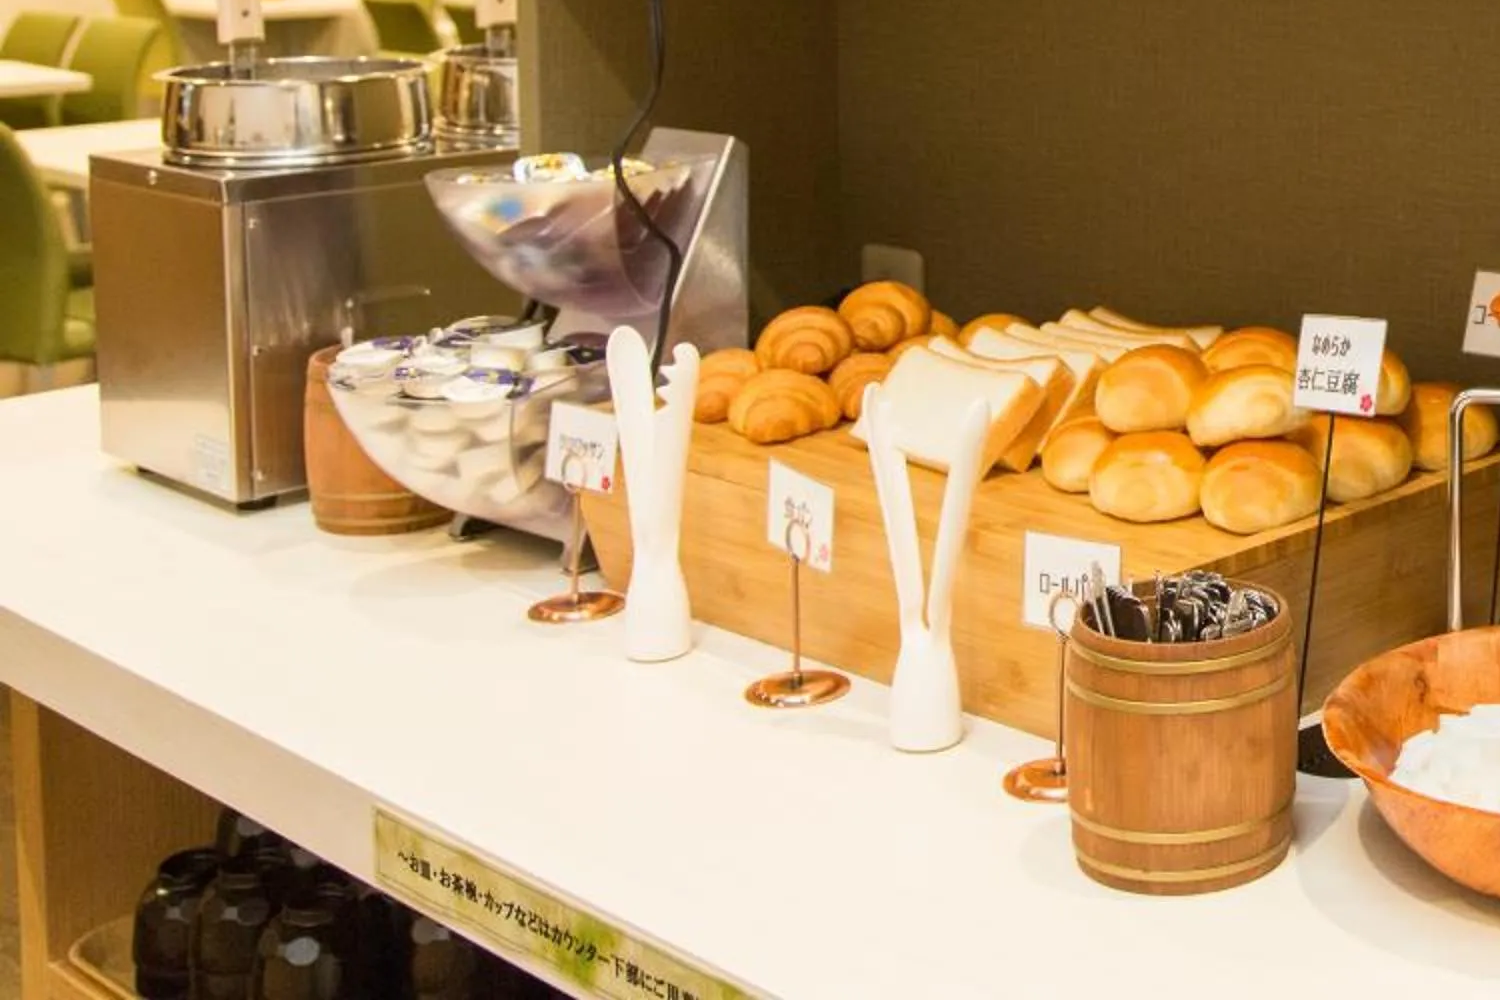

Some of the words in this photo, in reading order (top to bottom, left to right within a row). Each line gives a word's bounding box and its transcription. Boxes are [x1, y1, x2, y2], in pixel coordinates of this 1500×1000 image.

[1312, 334, 1352, 357] なめらか
[1297, 367, 1361, 396] 杏仁豆腐
